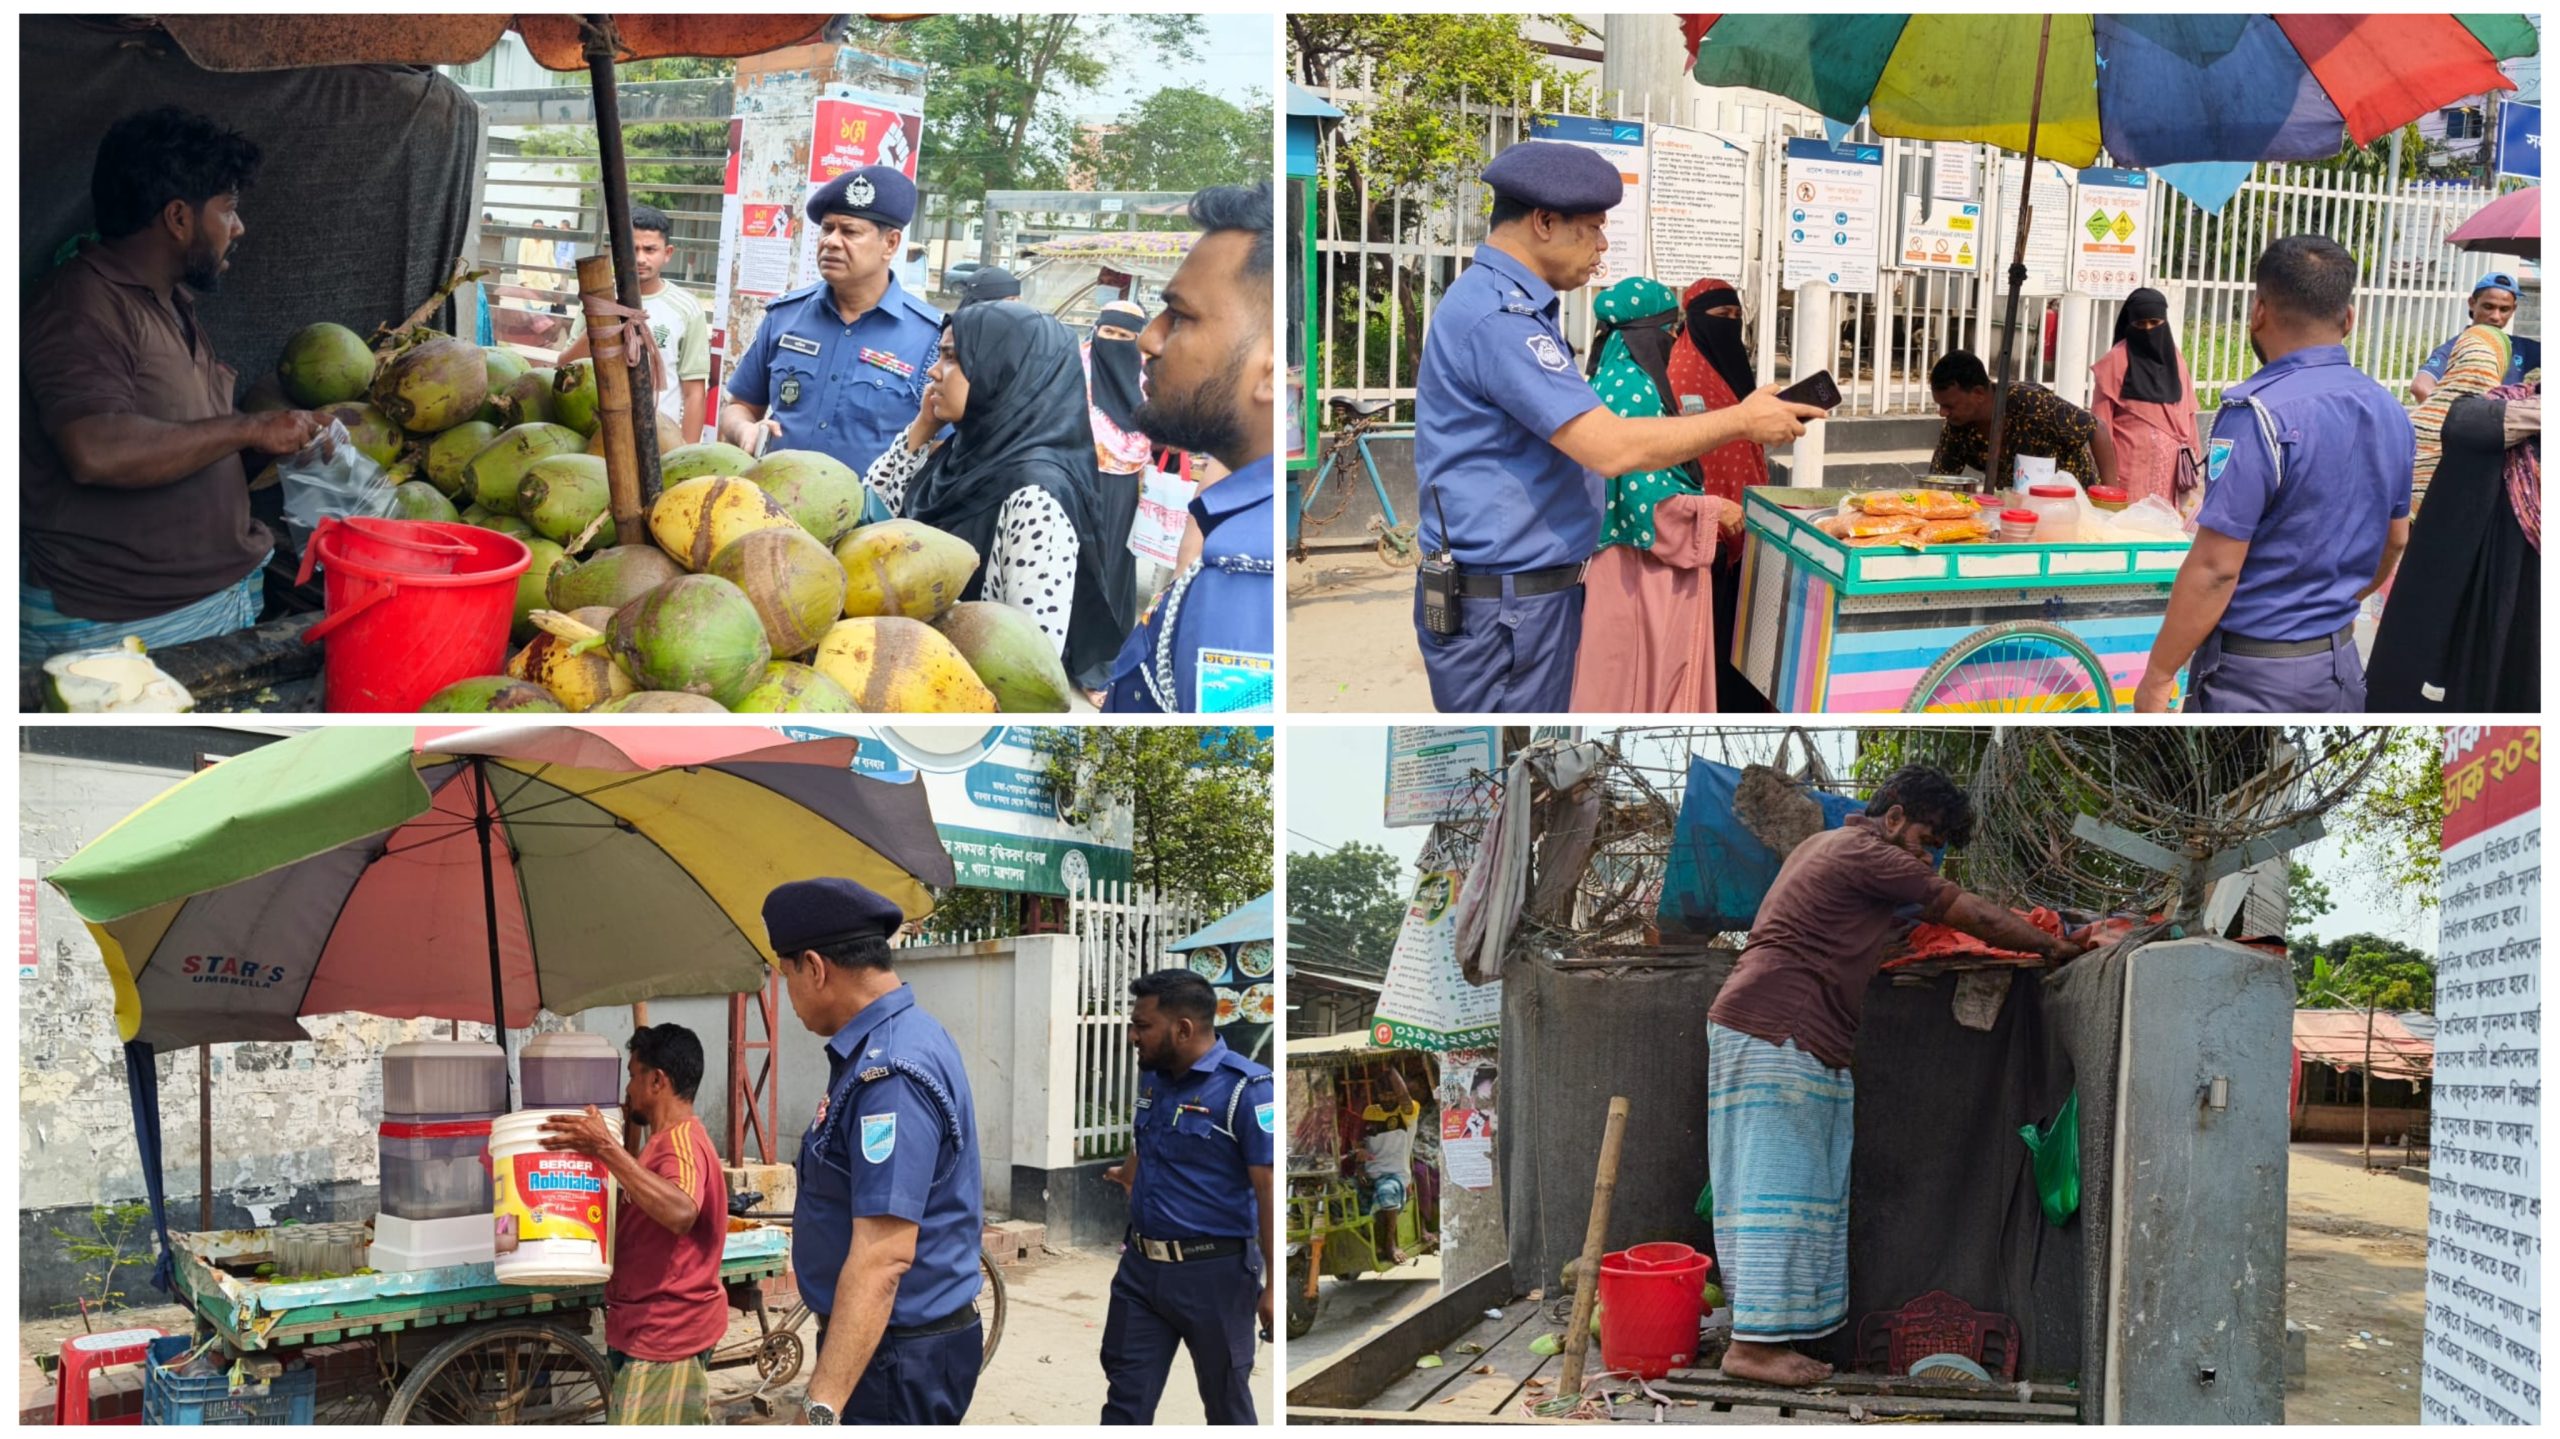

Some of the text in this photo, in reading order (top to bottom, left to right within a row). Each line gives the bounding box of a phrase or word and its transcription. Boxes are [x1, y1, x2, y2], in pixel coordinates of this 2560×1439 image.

[2471, 911, 2499, 933] করতে
[192, 975, 272, 989] UMBRELLA
[2446, 978, 2473, 1002] নিশ্চিত
[2475, 977, 2506, 999] করতে
[2468, 1042, 2487, 1068] নারী
[2489, 1042, 2539, 1068] শ্রমিকদের
[2480, 1085, 2506, 1106] সকল
[2440, 1116, 2471, 1141] মানুষের
[2472, 1119, 2494, 1141] জন্য
[539, 1160, 593, 1171] BERGER
[2440, 1139, 2467, 1166] নিশ্চিত
[2469, 1150, 2499, 1171] করতে
[529, 1171, 601, 1192] Robbialac
[2508, 1192, 2528, 1219] মূল্য
[2453, 1209, 2509, 1247] কীটনাশকের
[2511, 1231, 2533, 1259] মূল্য
[2439, 1234, 2467, 1264] নিশ্চিত
[2469, 1250, 2498, 1274] করতে
[2451, 1275, 2495, 1312] শ্রমিকদের
[2463, 1311, 2503, 1352] চাঁদাবাজি
[2465, 1350, 2488, 1376] সহজ
[2489, 1362, 2520, 1394] করতে
